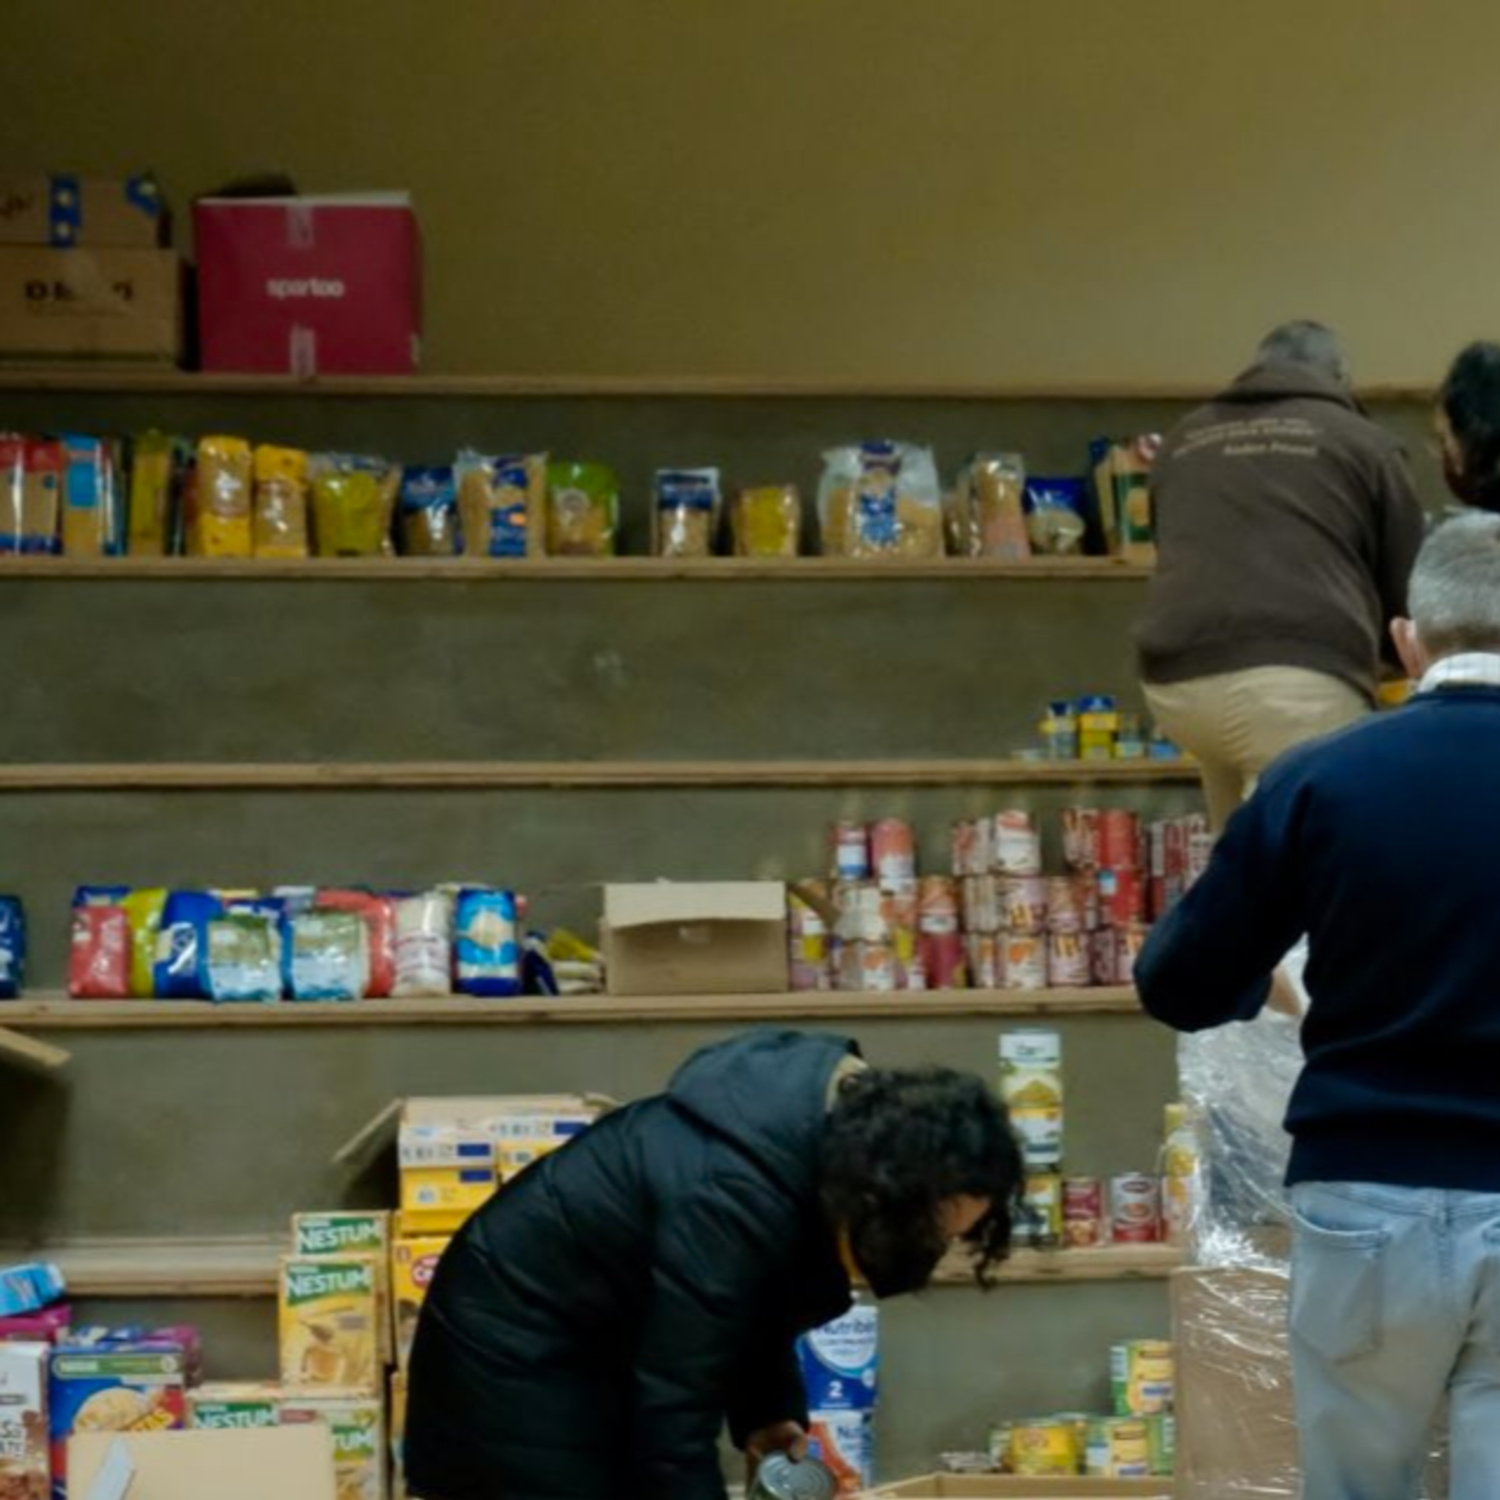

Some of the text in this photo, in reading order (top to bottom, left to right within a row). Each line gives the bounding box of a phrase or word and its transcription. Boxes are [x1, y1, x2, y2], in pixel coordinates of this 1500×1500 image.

[266, 278, 345, 299] spartoo
[298, 1223, 381, 1250] NESTUM
[287, 1267, 372, 1297] NESTUM
[829, 1381, 843, 1398] 2
[195, 1409, 278, 1428] NESTUM
[333, 1430, 373, 1450] TUM
